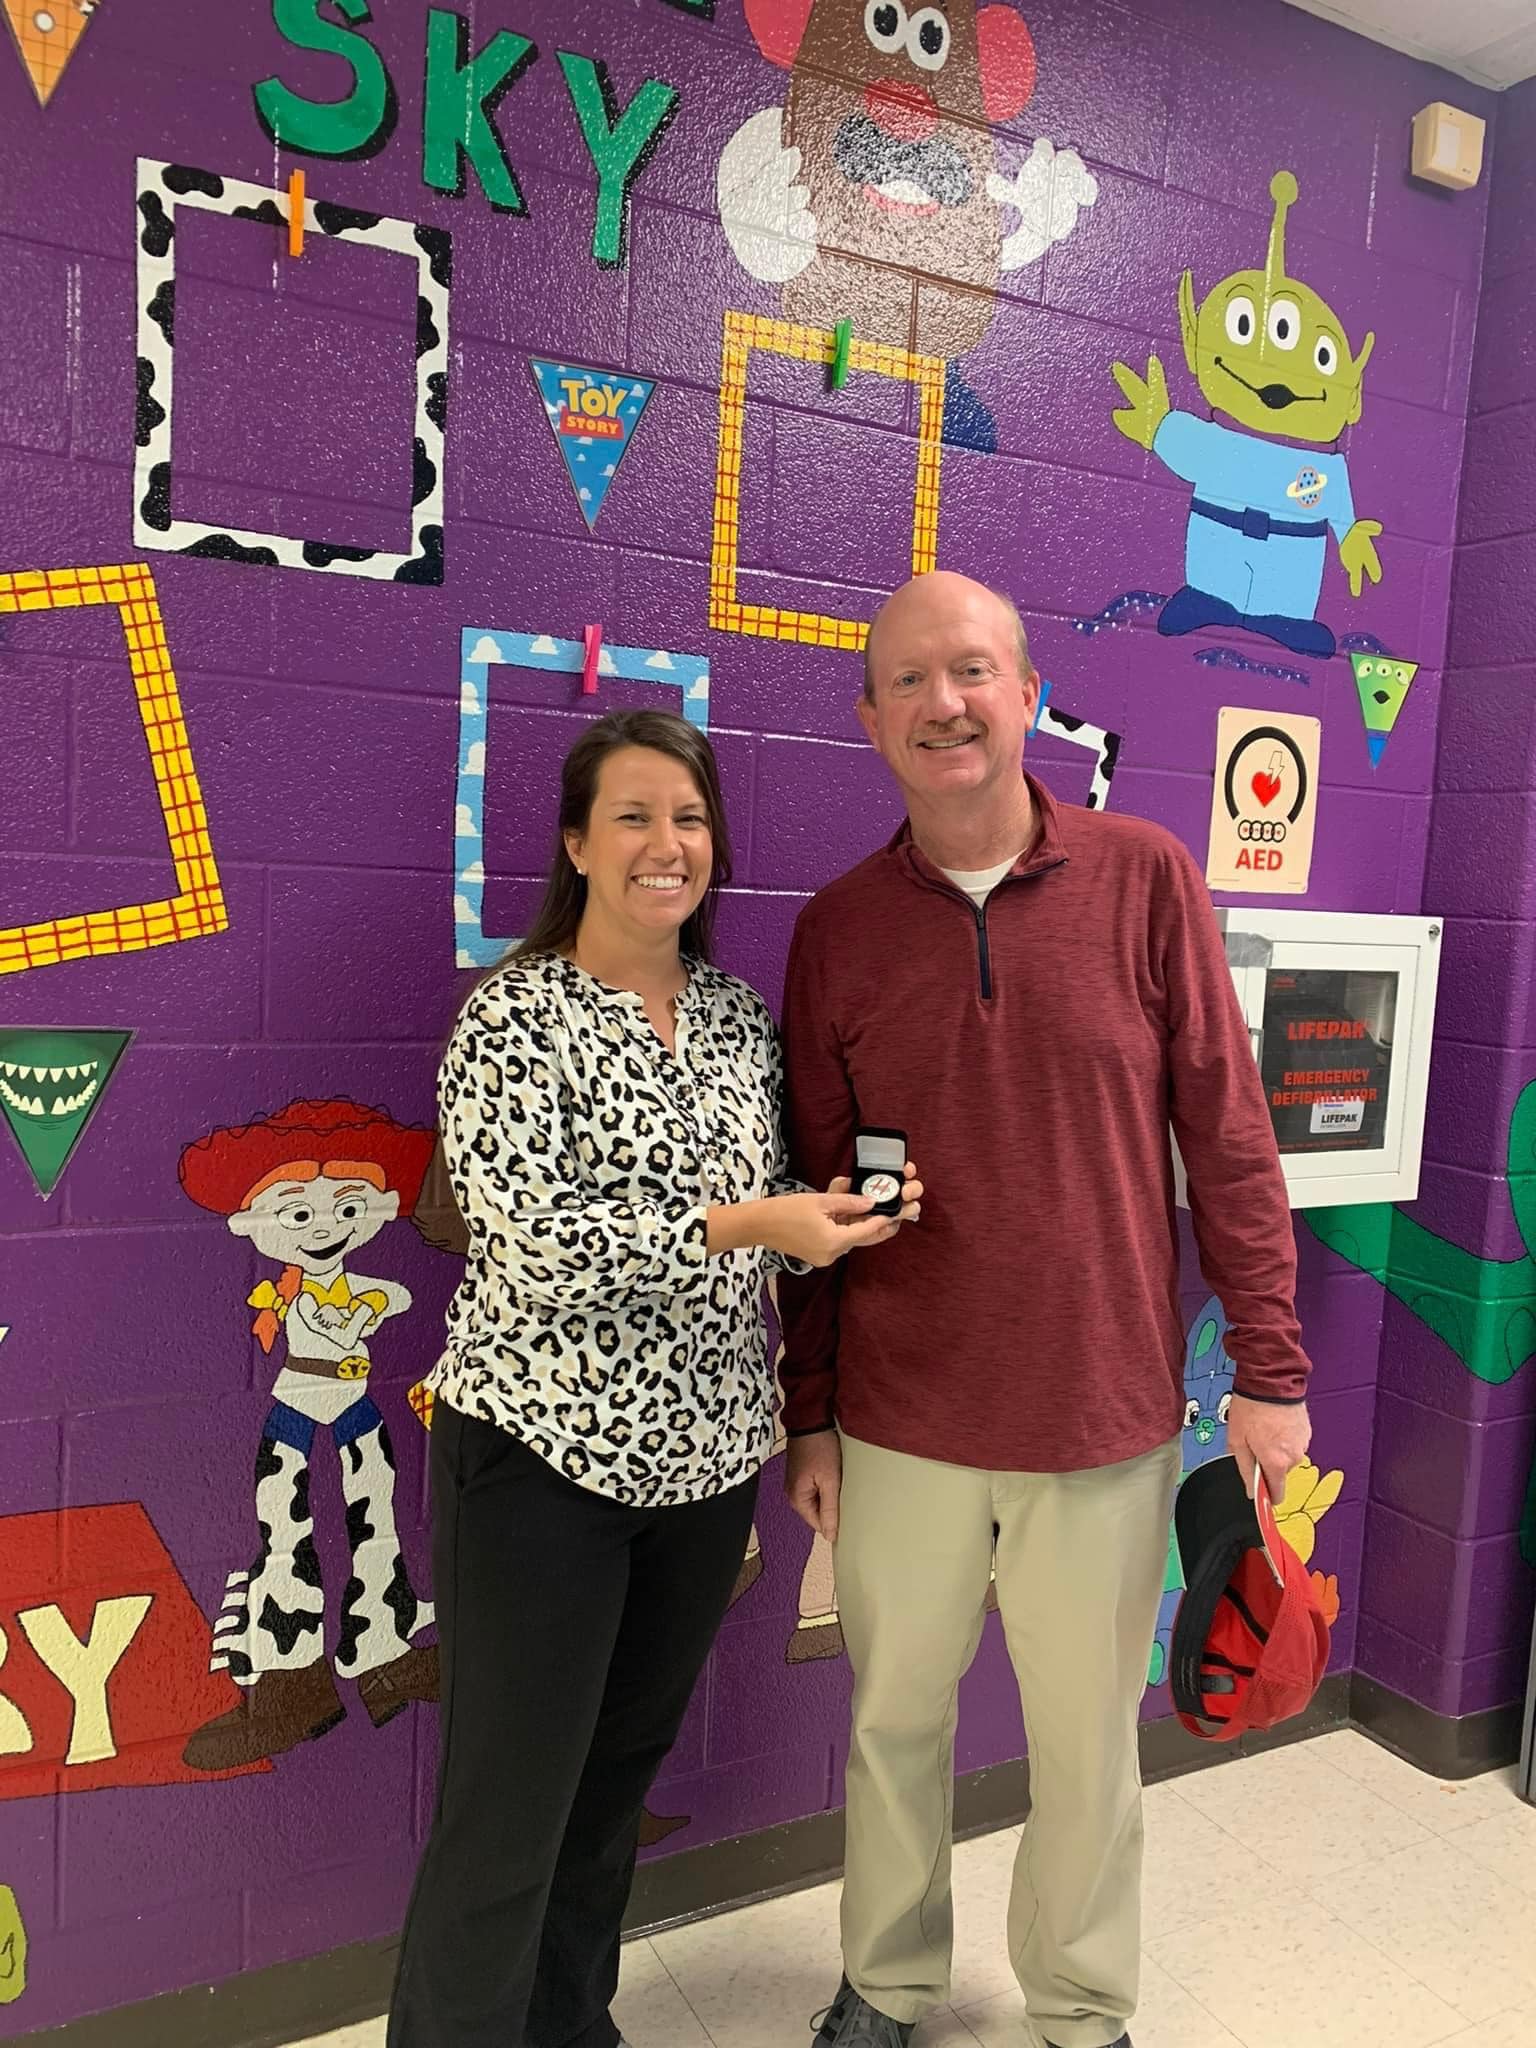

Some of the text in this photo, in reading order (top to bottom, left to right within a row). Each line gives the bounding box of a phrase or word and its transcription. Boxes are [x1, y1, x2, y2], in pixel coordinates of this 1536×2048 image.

[254, 0, 681, 272] SKY
[560, 378, 630, 418] TOY
[566, 415, 620, 435] STORY
[1234, 847, 1284, 872] AED
[1287, 1018, 1367, 1041] LIFEPAK
[1283, 1069, 1370, 1086] EMERGENCY
[1272, 1088, 1377, 1106] DEFIBRILLATOR
[1321, 1113, 1359, 1124] LIFEPAK
